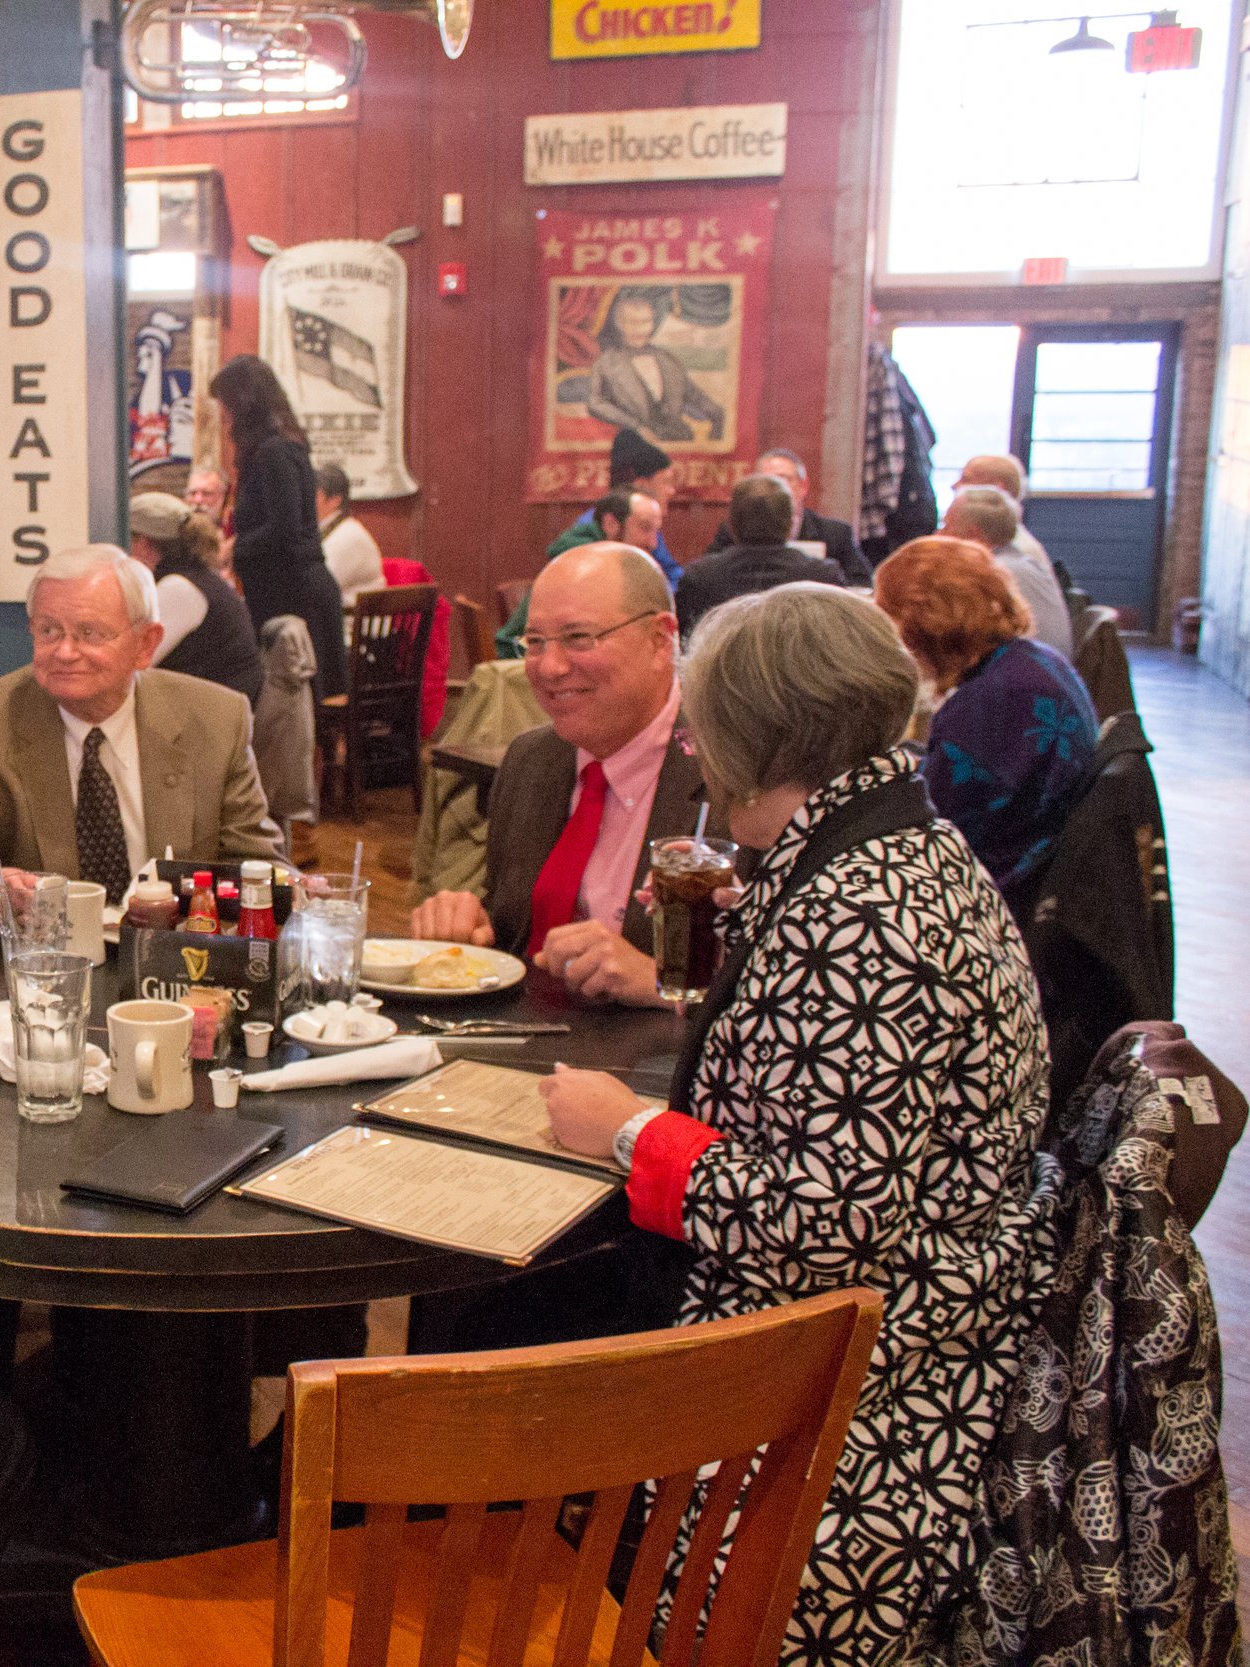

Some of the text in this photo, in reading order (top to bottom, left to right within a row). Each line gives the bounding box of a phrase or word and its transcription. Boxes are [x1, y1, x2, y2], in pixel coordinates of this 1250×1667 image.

[533, 120, 777, 166] White House Coffee
[2, 119, 52, 327] GOOD
[573, 216, 721, 241] JAMES K
[572, 240, 727, 272] POLK
[9, 363, 52, 566] EATS
[141, 976, 251, 1011] GUISS
